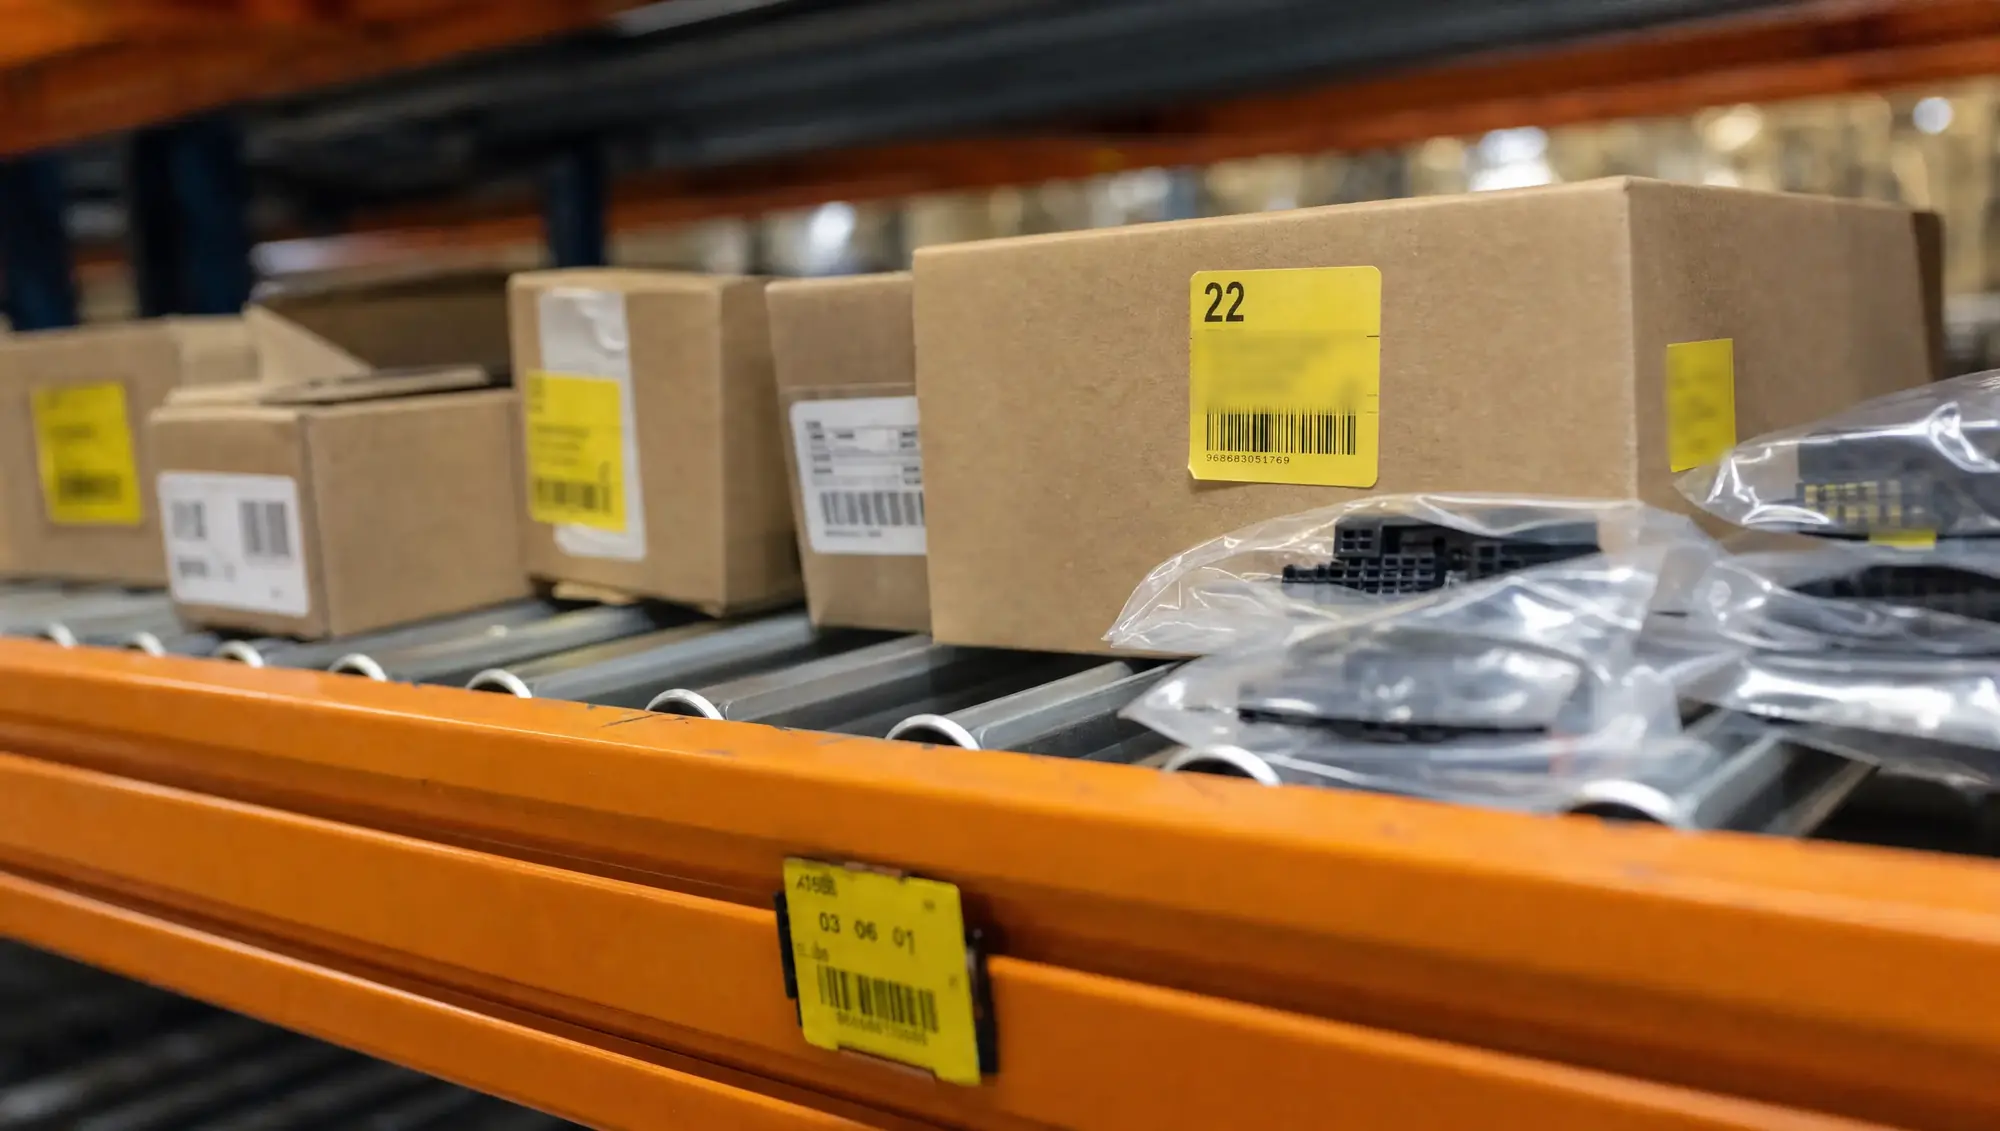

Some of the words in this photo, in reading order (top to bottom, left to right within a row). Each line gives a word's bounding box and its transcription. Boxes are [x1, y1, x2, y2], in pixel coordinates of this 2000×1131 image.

[1204, 281, 1245, 323] 22
[1206, 453, 1290, 465] 968683051769
[819, 911, 841, 934] 03
[854, 919, 878, 942] 06
[892, 925, 915, 956] 01
